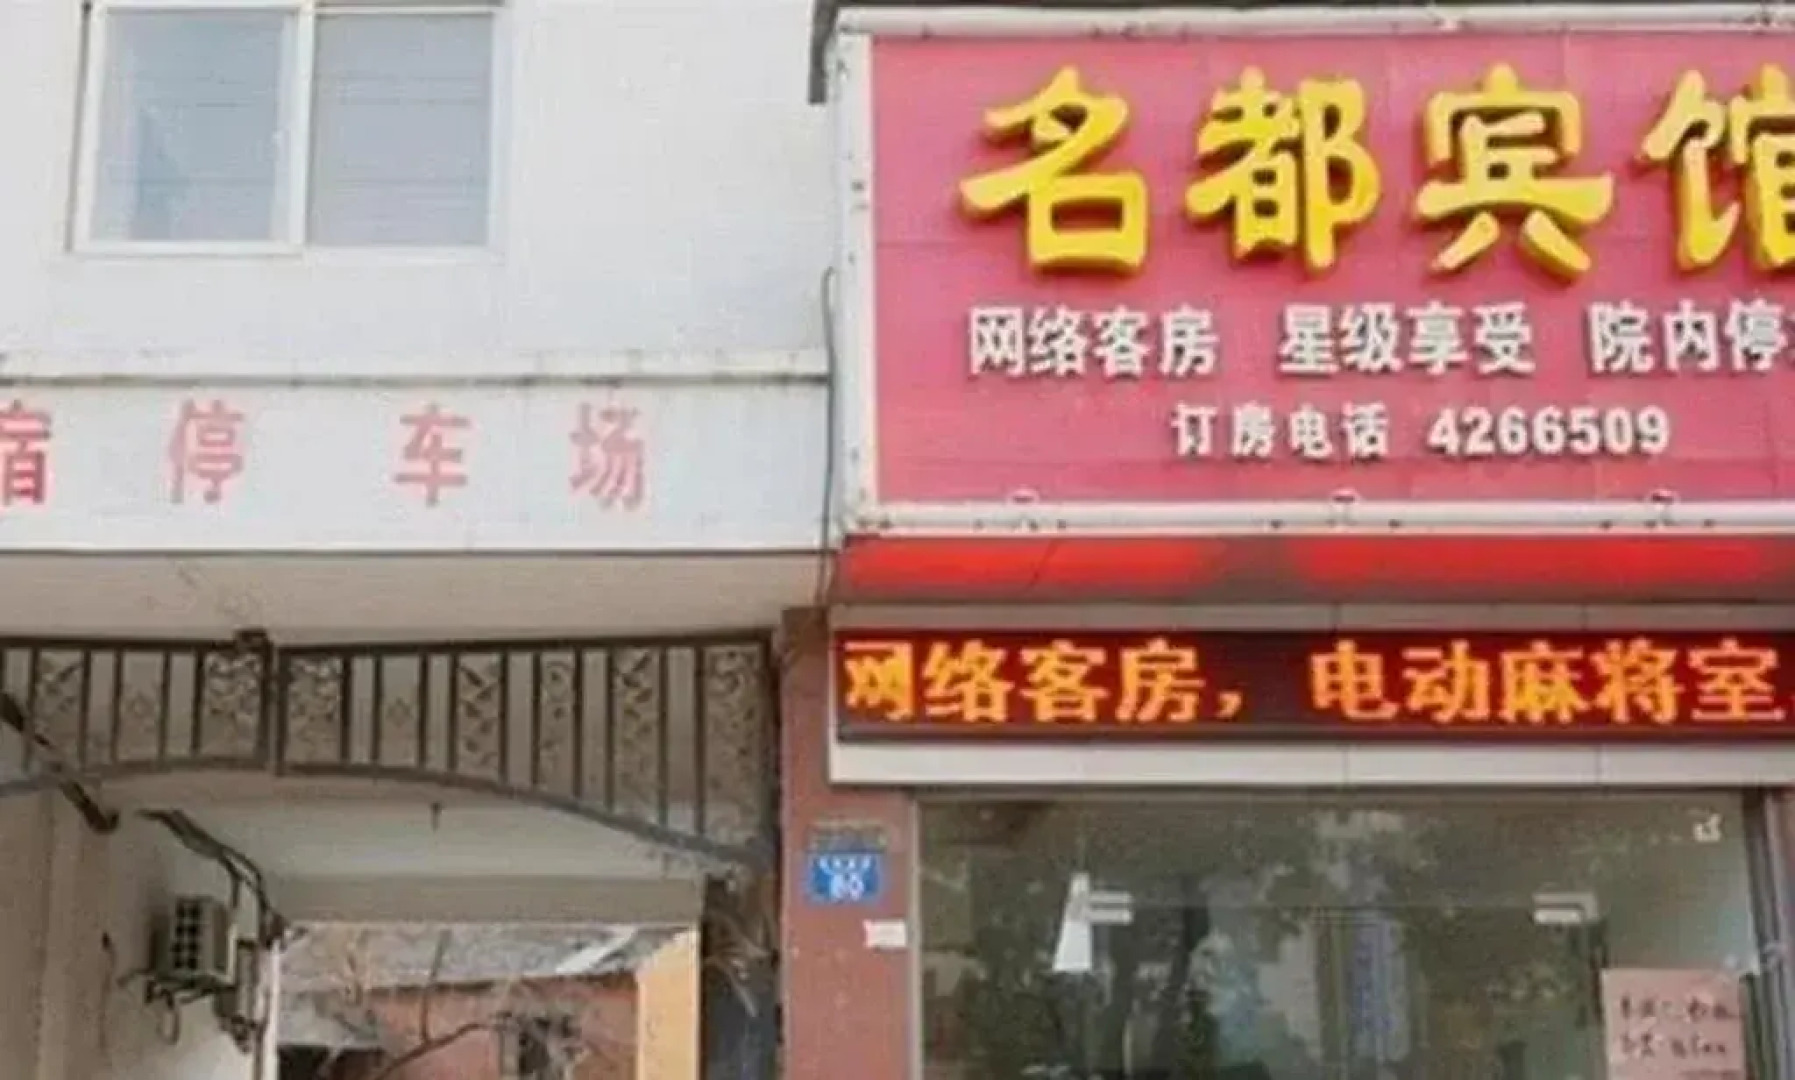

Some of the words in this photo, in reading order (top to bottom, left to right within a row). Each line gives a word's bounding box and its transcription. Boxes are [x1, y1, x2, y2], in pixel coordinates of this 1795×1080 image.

[959, 63, 1795, 279] 名都宾馆
[969, 304, 1219, 376] 网络客房
[1278, 301, 1536, 375] 星级享受
[1587, 297, 1795, 374] 院内停
[1170, 401, 1390, 458] 订房电话
[1427, 404, 1670, 456] 4266509
